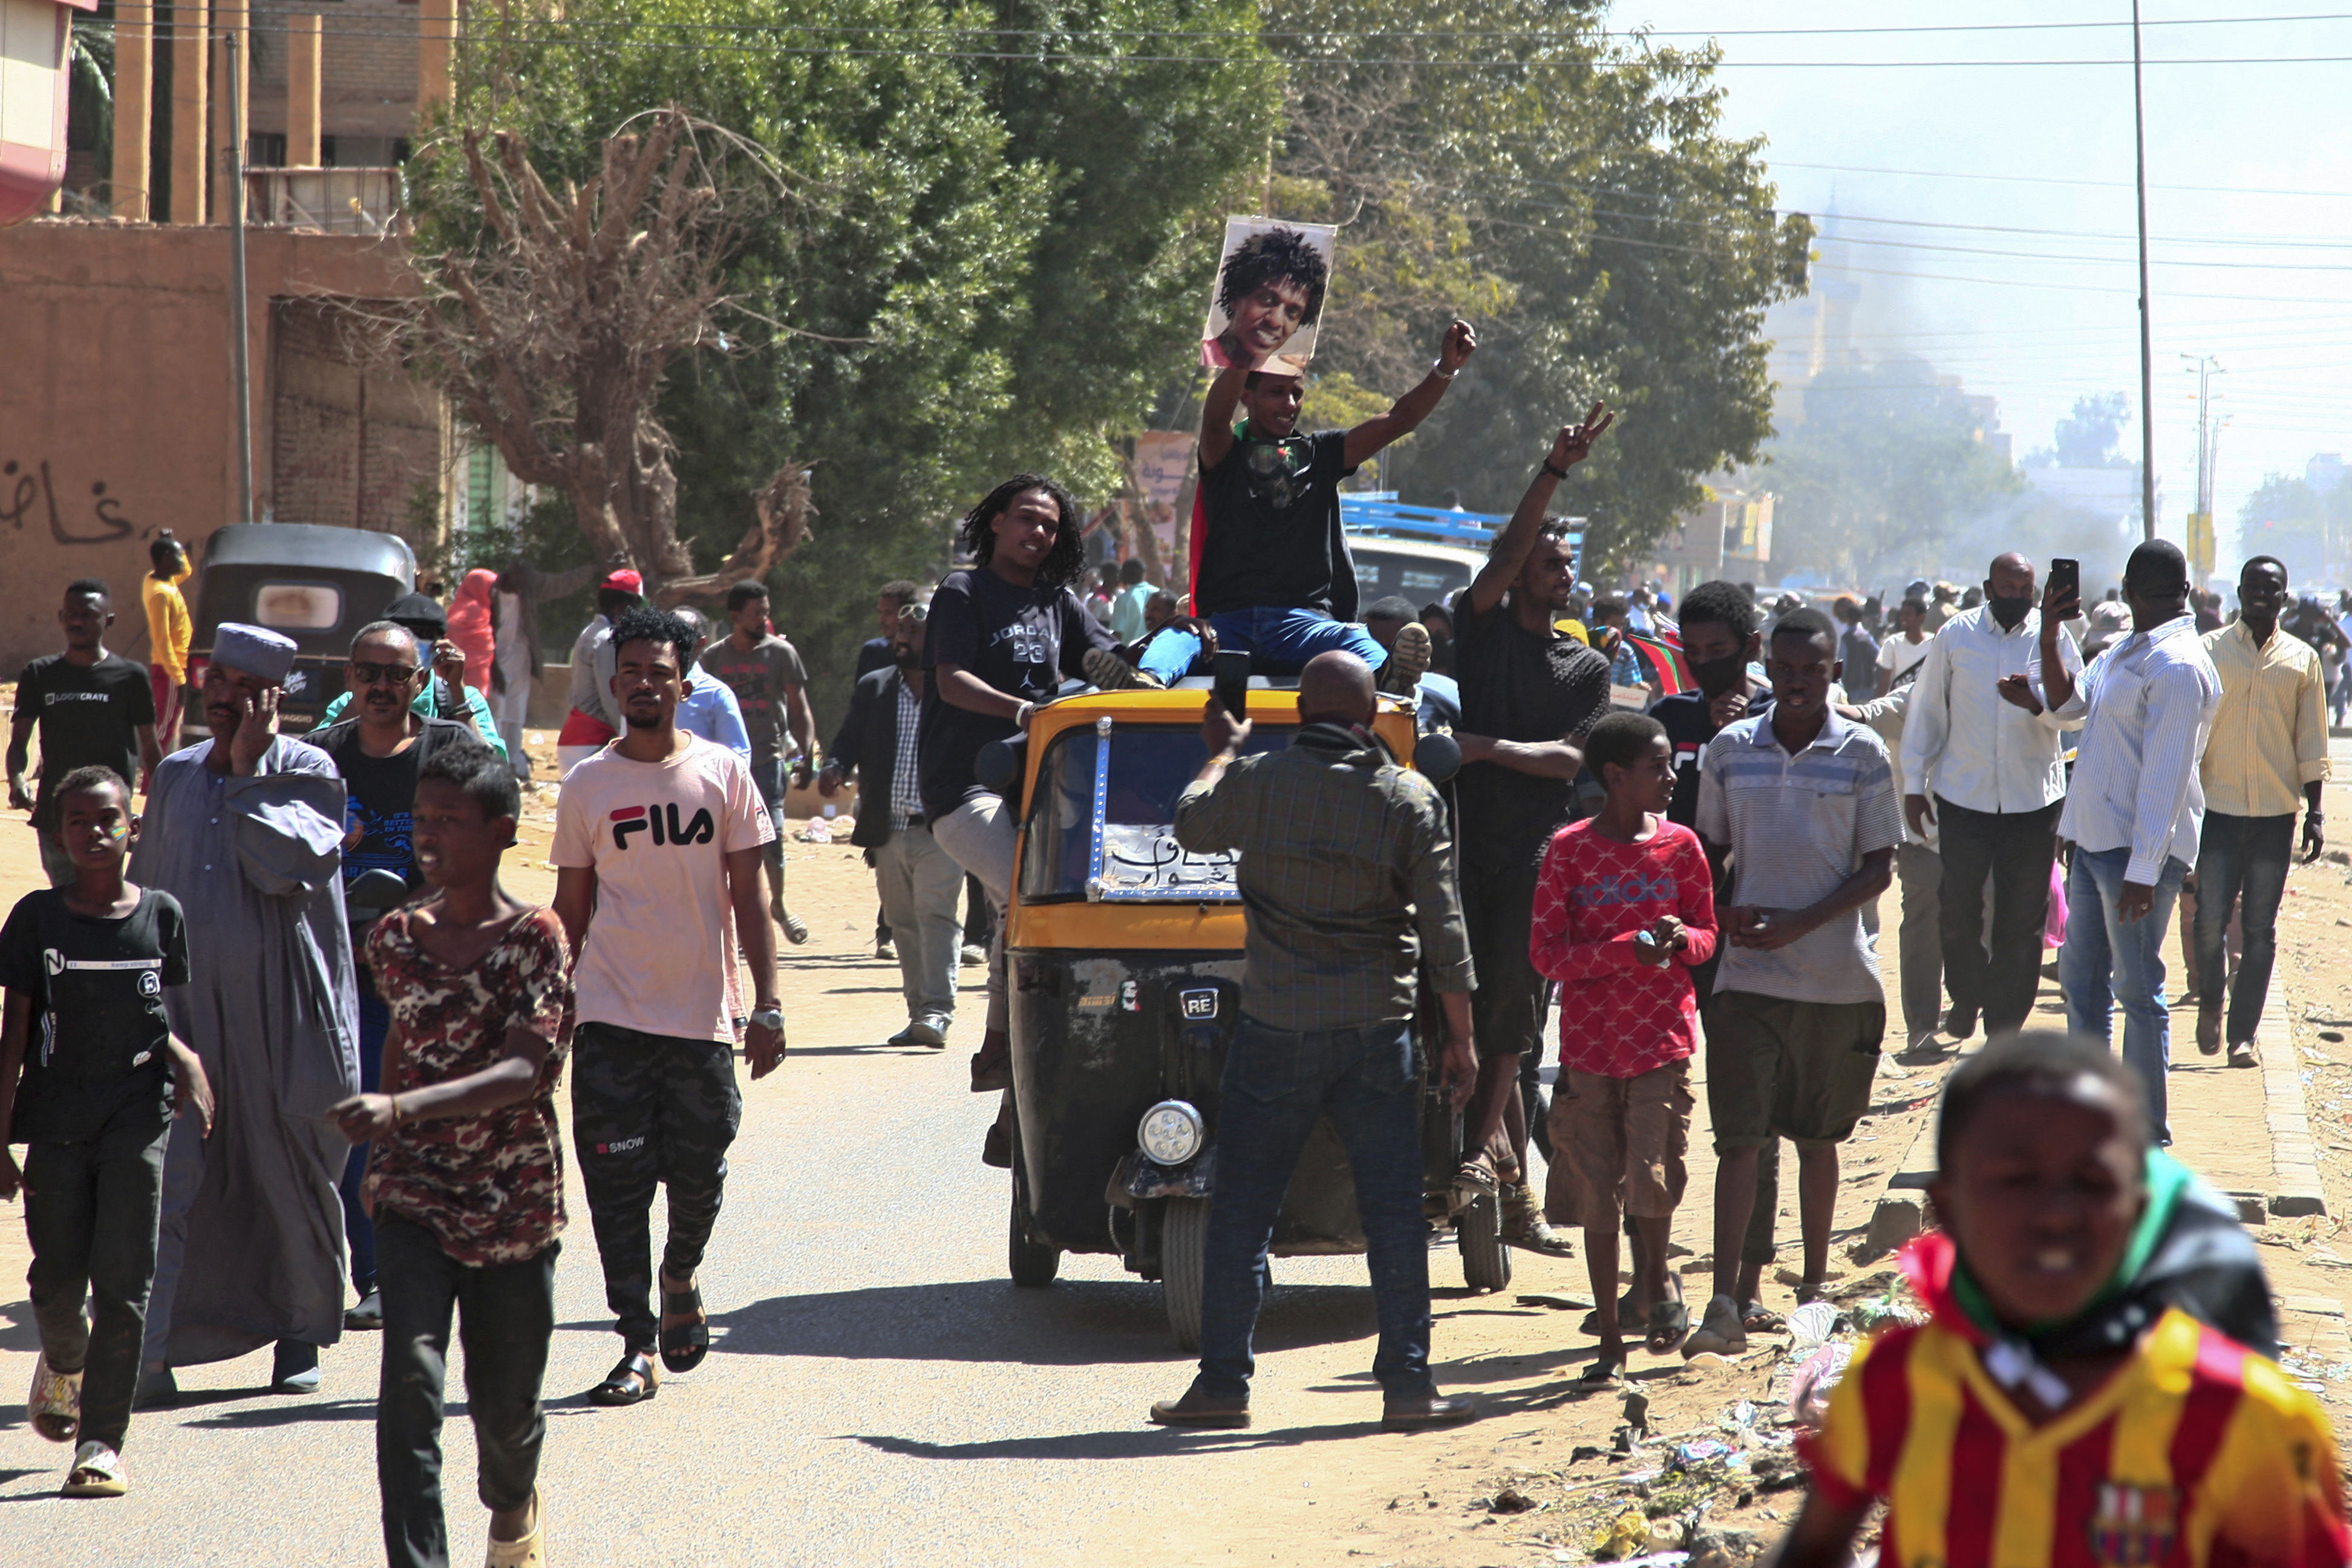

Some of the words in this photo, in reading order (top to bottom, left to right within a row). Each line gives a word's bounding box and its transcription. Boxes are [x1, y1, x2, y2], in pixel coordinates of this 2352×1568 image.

[990, 624, 1059, 648] JORDAN
[1013, 641, 1047, 663] 23
[1674, 742, 1708, 772] FI
[610, 802, 714, 850] FILA
[1572, 872, 1679, 906] adidas
[1187, 999, 1211, 1014] RE
[609, 1136, 645, 1154] SNOW
